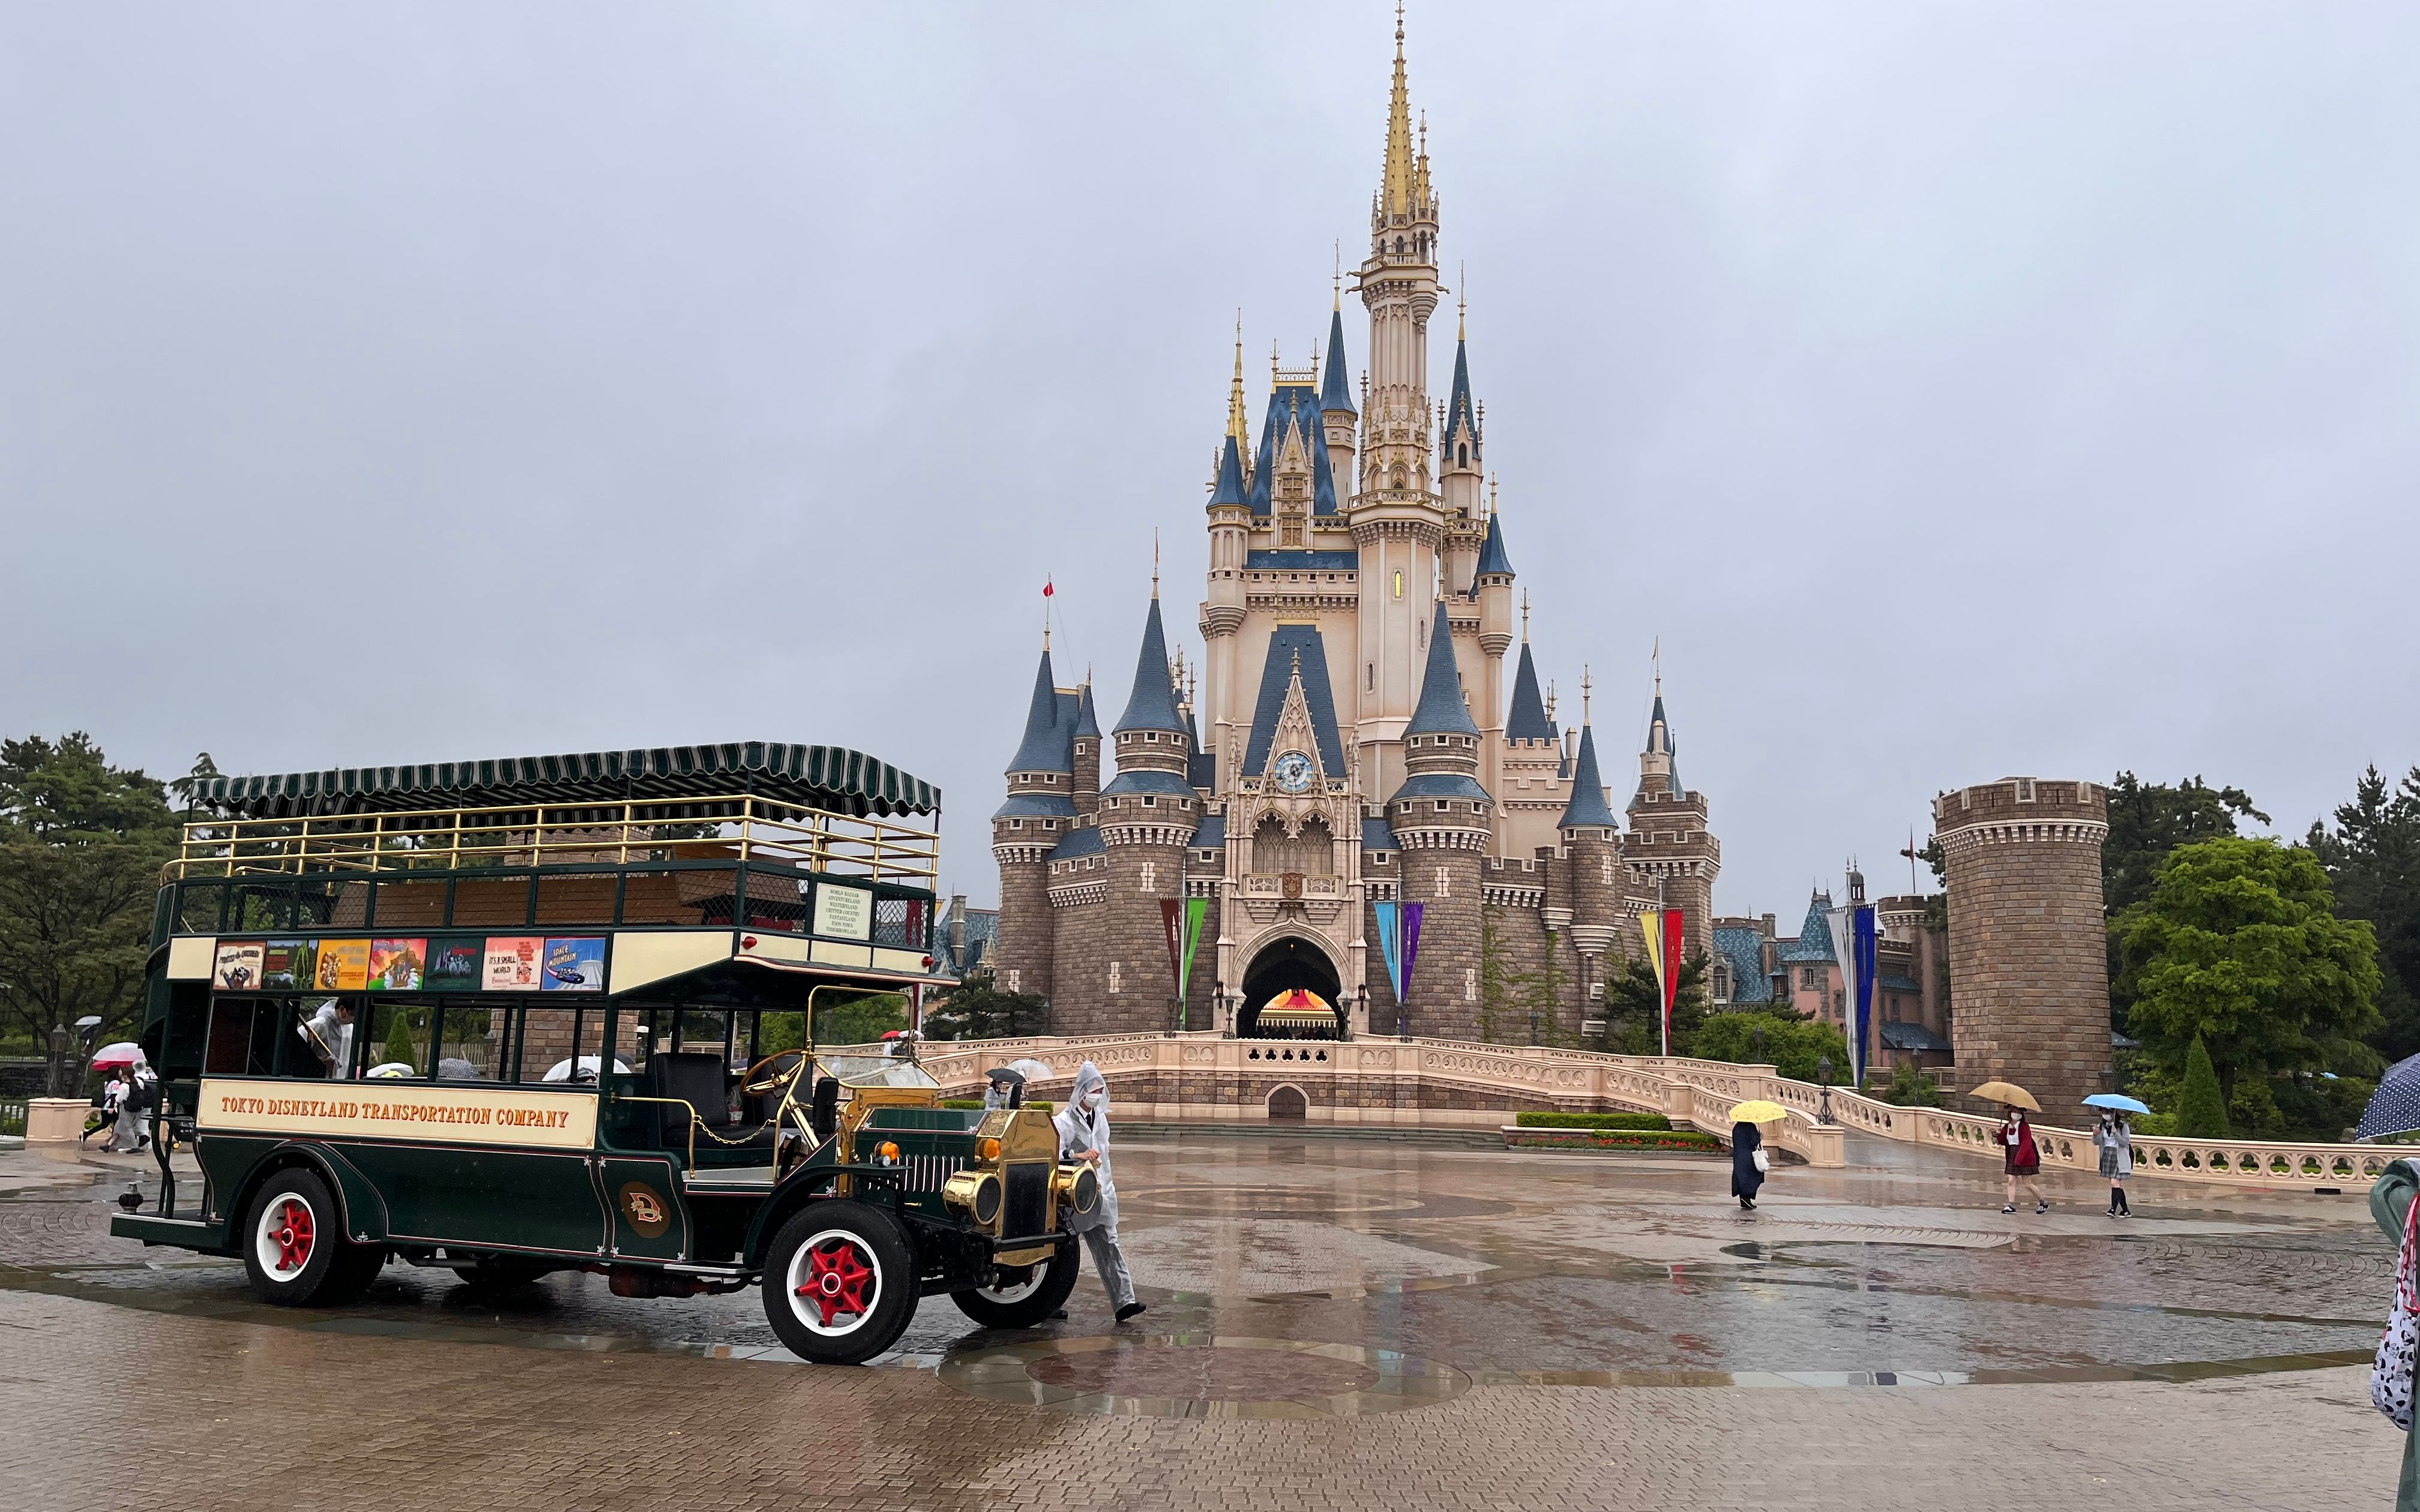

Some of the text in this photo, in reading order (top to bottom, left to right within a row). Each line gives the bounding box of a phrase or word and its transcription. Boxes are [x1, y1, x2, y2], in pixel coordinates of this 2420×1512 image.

[553, 945, 569, 956] SPACE
[501, 956, 516, 964] SMALL
[549, 952, 576, 967] MOUNTAIN
[221, 1097, 570, 1128] TOKYO DISNEYLAND TRANSPORTATION COMPANY
